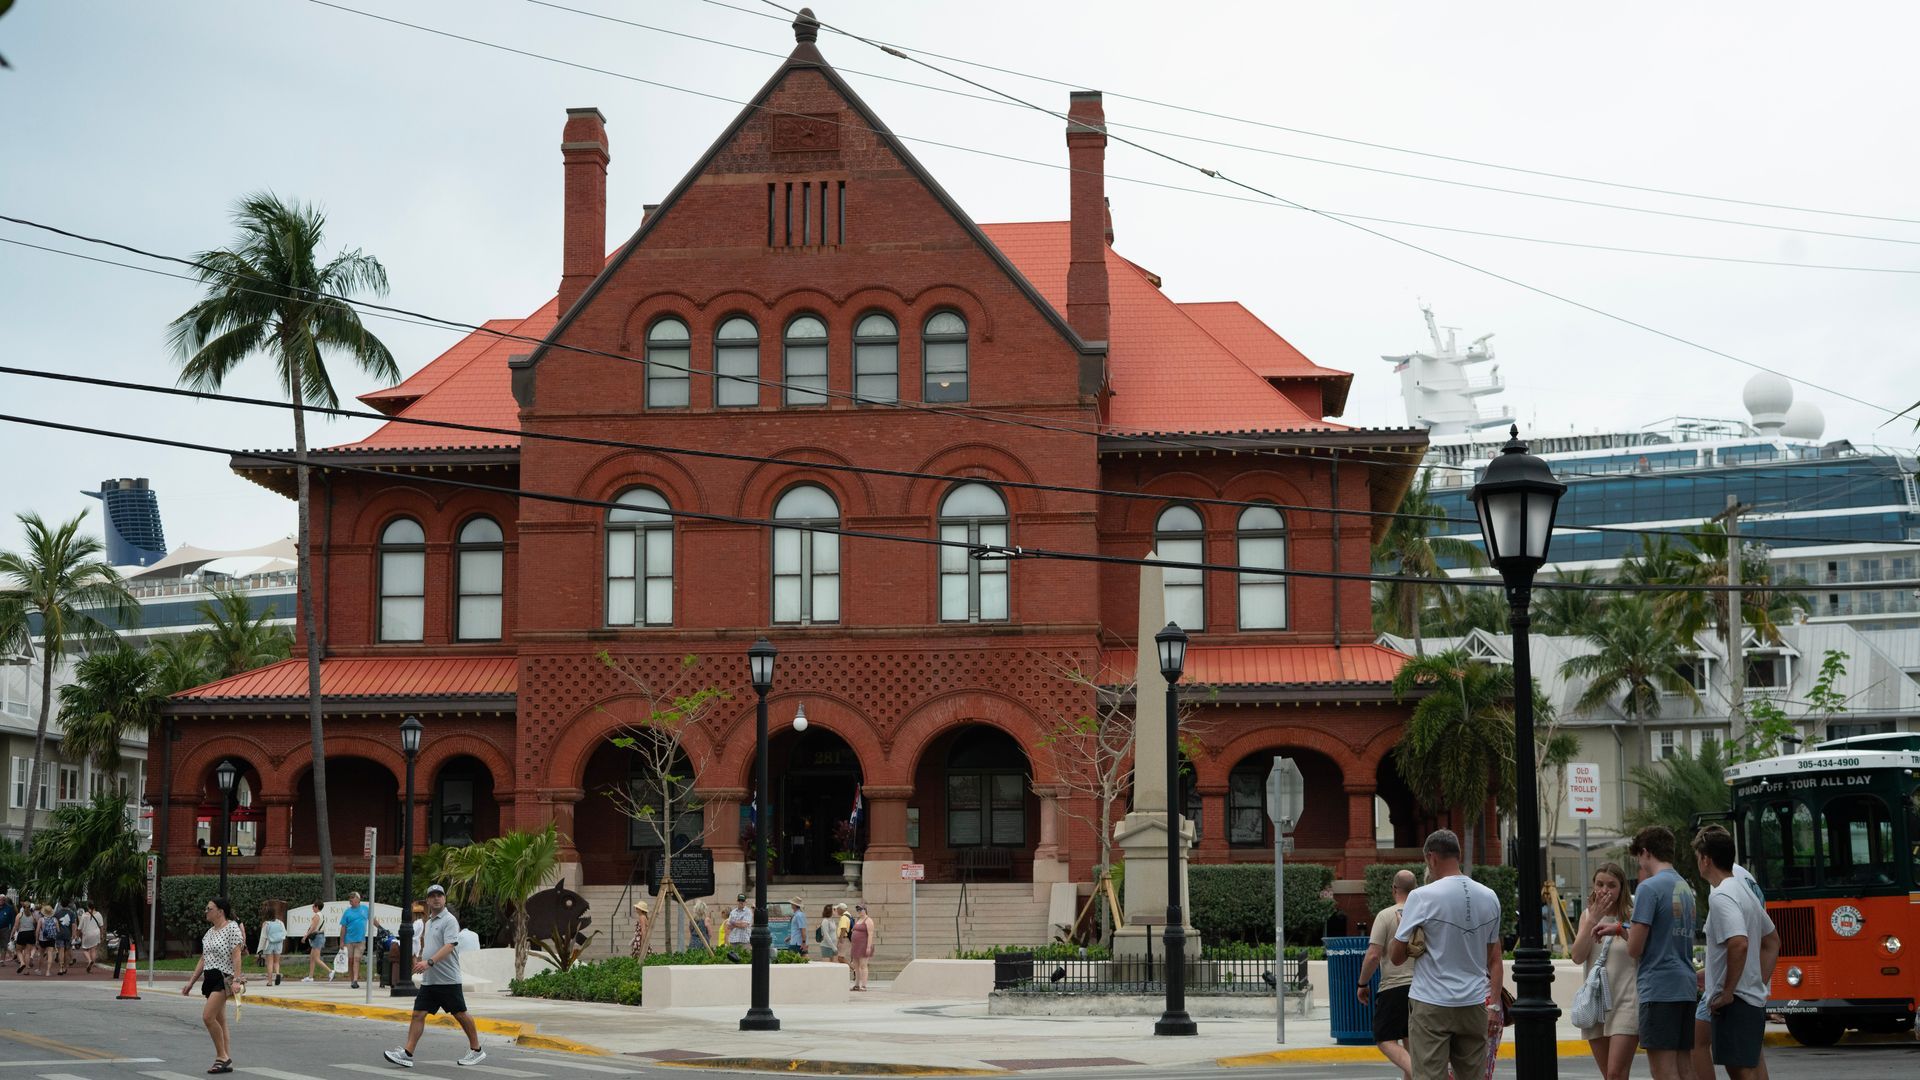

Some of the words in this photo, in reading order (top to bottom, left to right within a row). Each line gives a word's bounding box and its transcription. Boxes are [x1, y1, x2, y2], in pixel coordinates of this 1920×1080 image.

[815, 751, 840, 764] 281
[1798, 758, 1860, 769] 305-434-4900
[1576, 767, 1589, 775] OLD
[1575, 776, 1593, 784] TOWN
[1766, 782, 1783, 792] OFF
[1790, 778, 1817, 790] TOUR
[1820, 776, 1844, 787] ALL
[1847, 775, 1872, 785] DAY
[1570, 785, 1598, 793] TROLLEY
